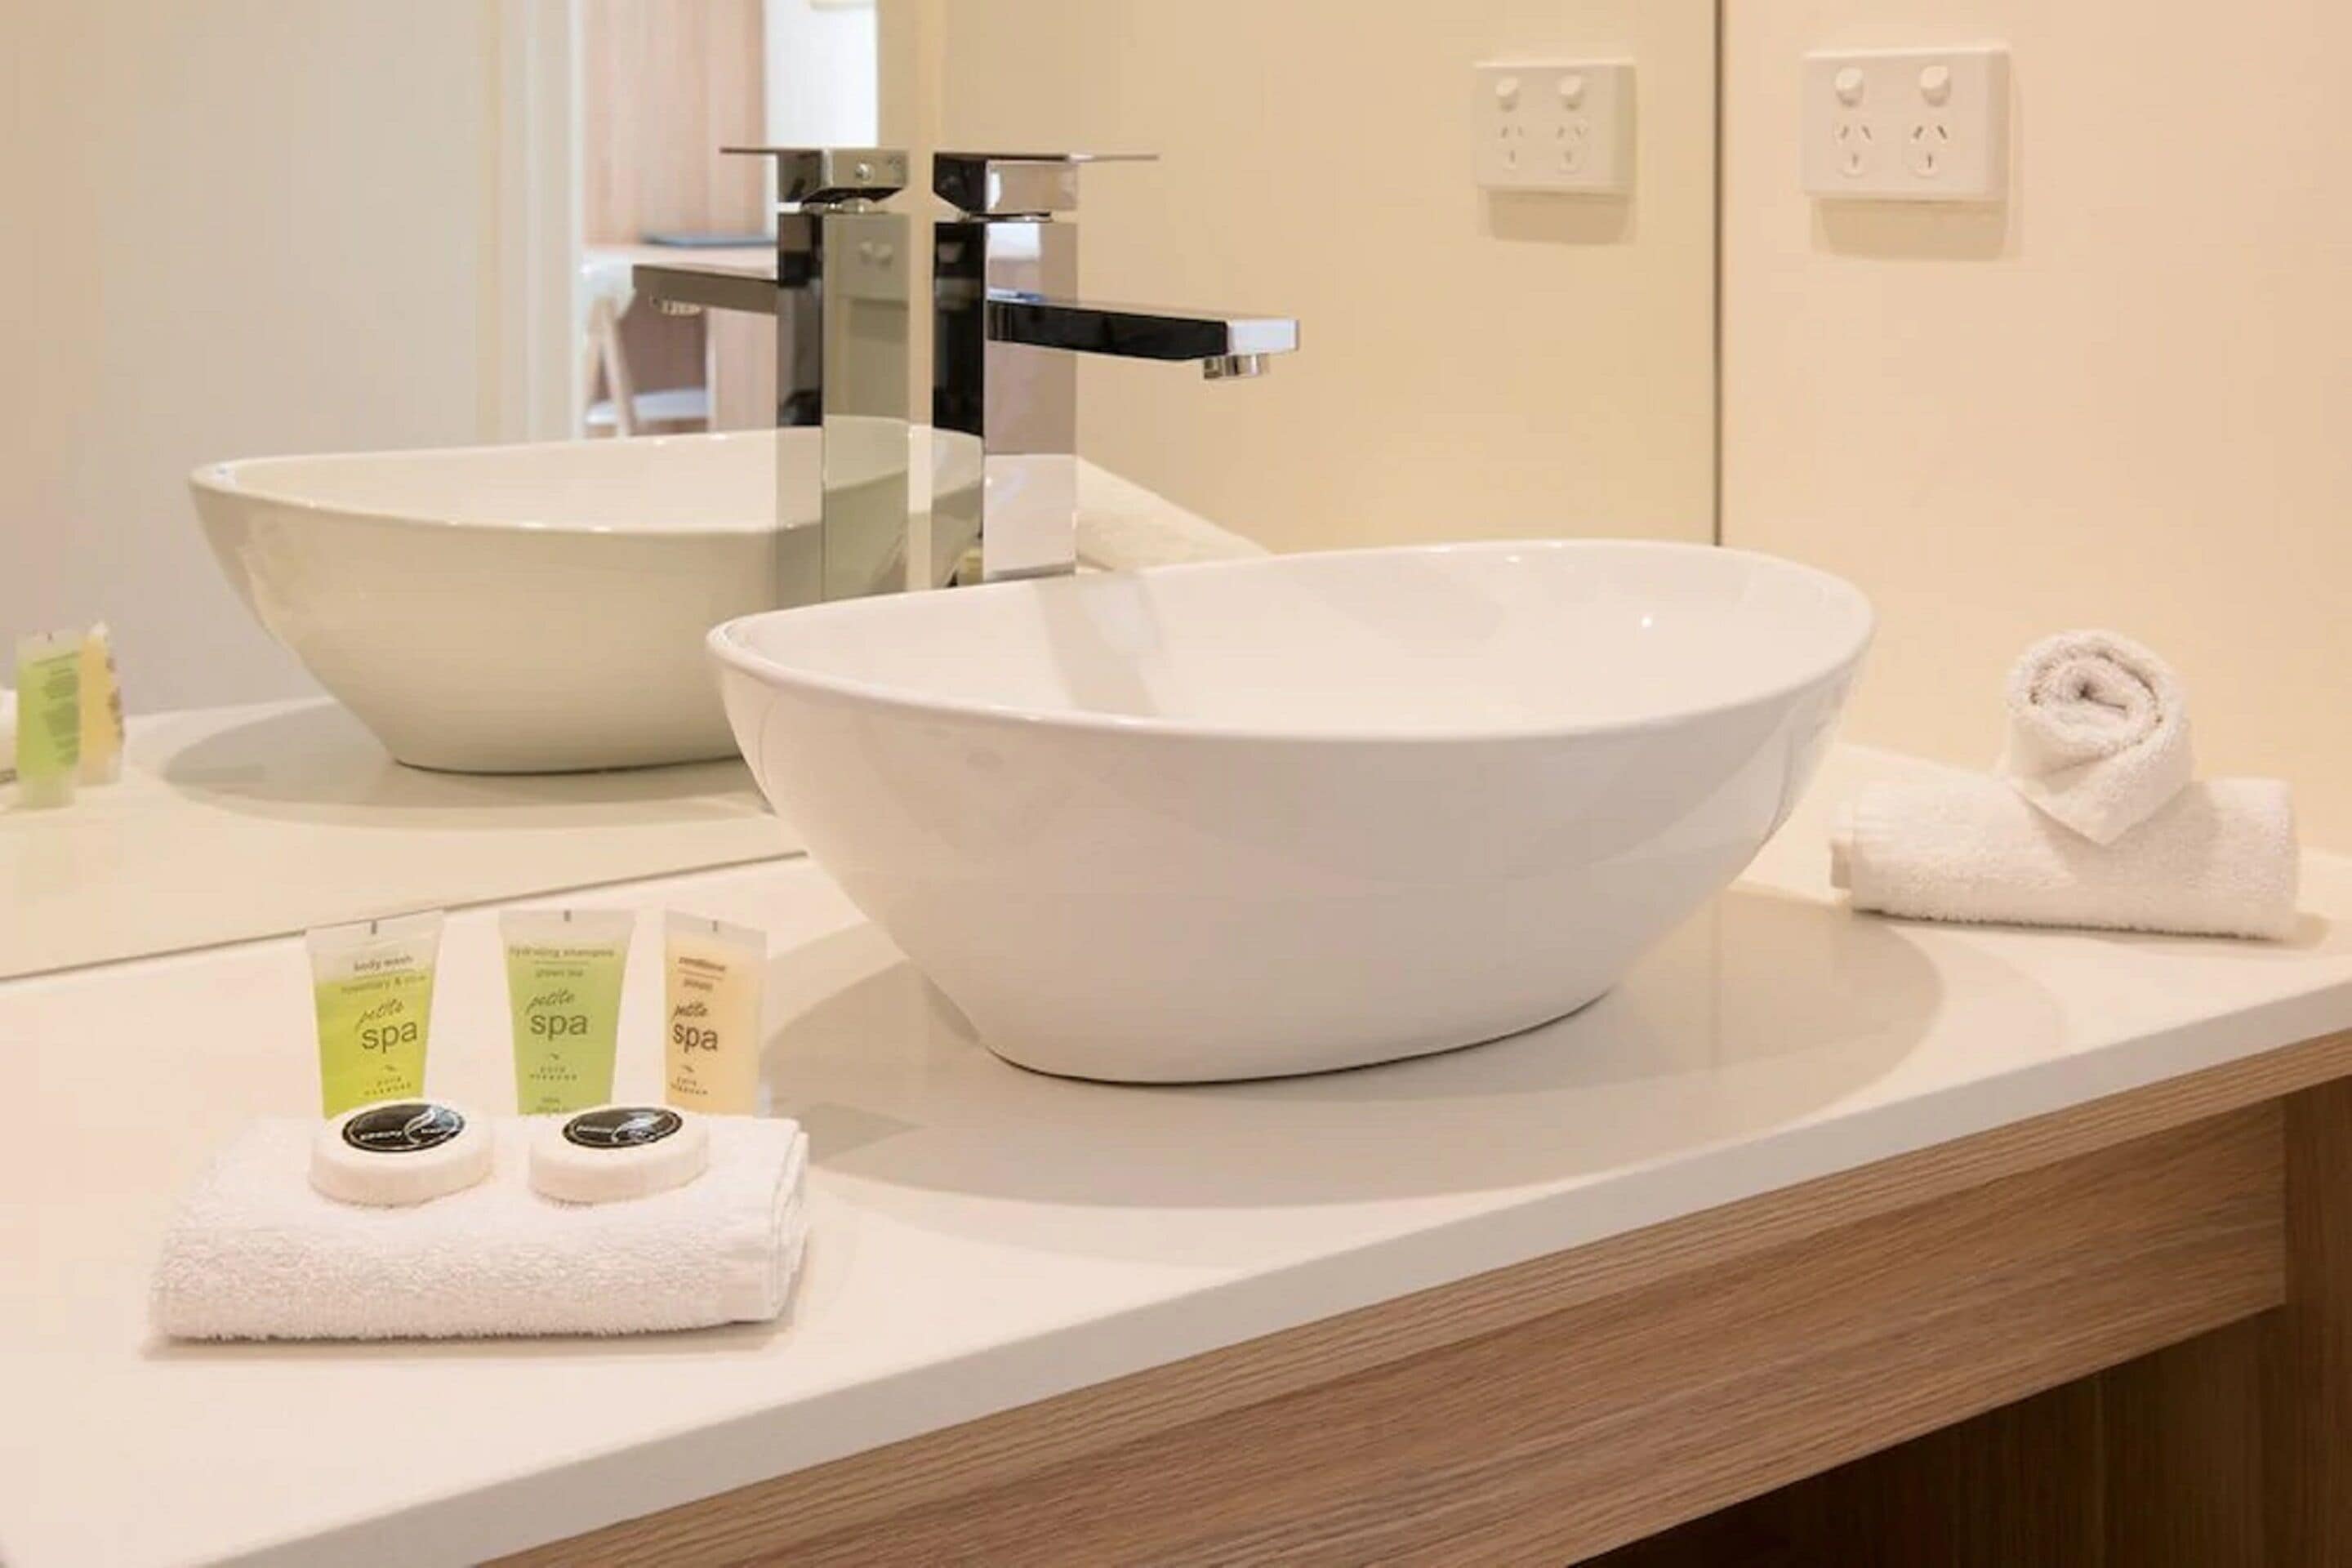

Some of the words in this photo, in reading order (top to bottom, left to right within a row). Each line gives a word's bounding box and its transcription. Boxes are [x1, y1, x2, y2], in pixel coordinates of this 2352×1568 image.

[353, 958, 382, 972] body
[383, 954, 414, 967] wash
[355, 998, 404, 1030] petite
[526, 988, 575, 1013] petite
[361, 1021, 418, 1054] spa
[530, 1013, 588, 1042] spa
[672, 1022, 719, 1054] spa
